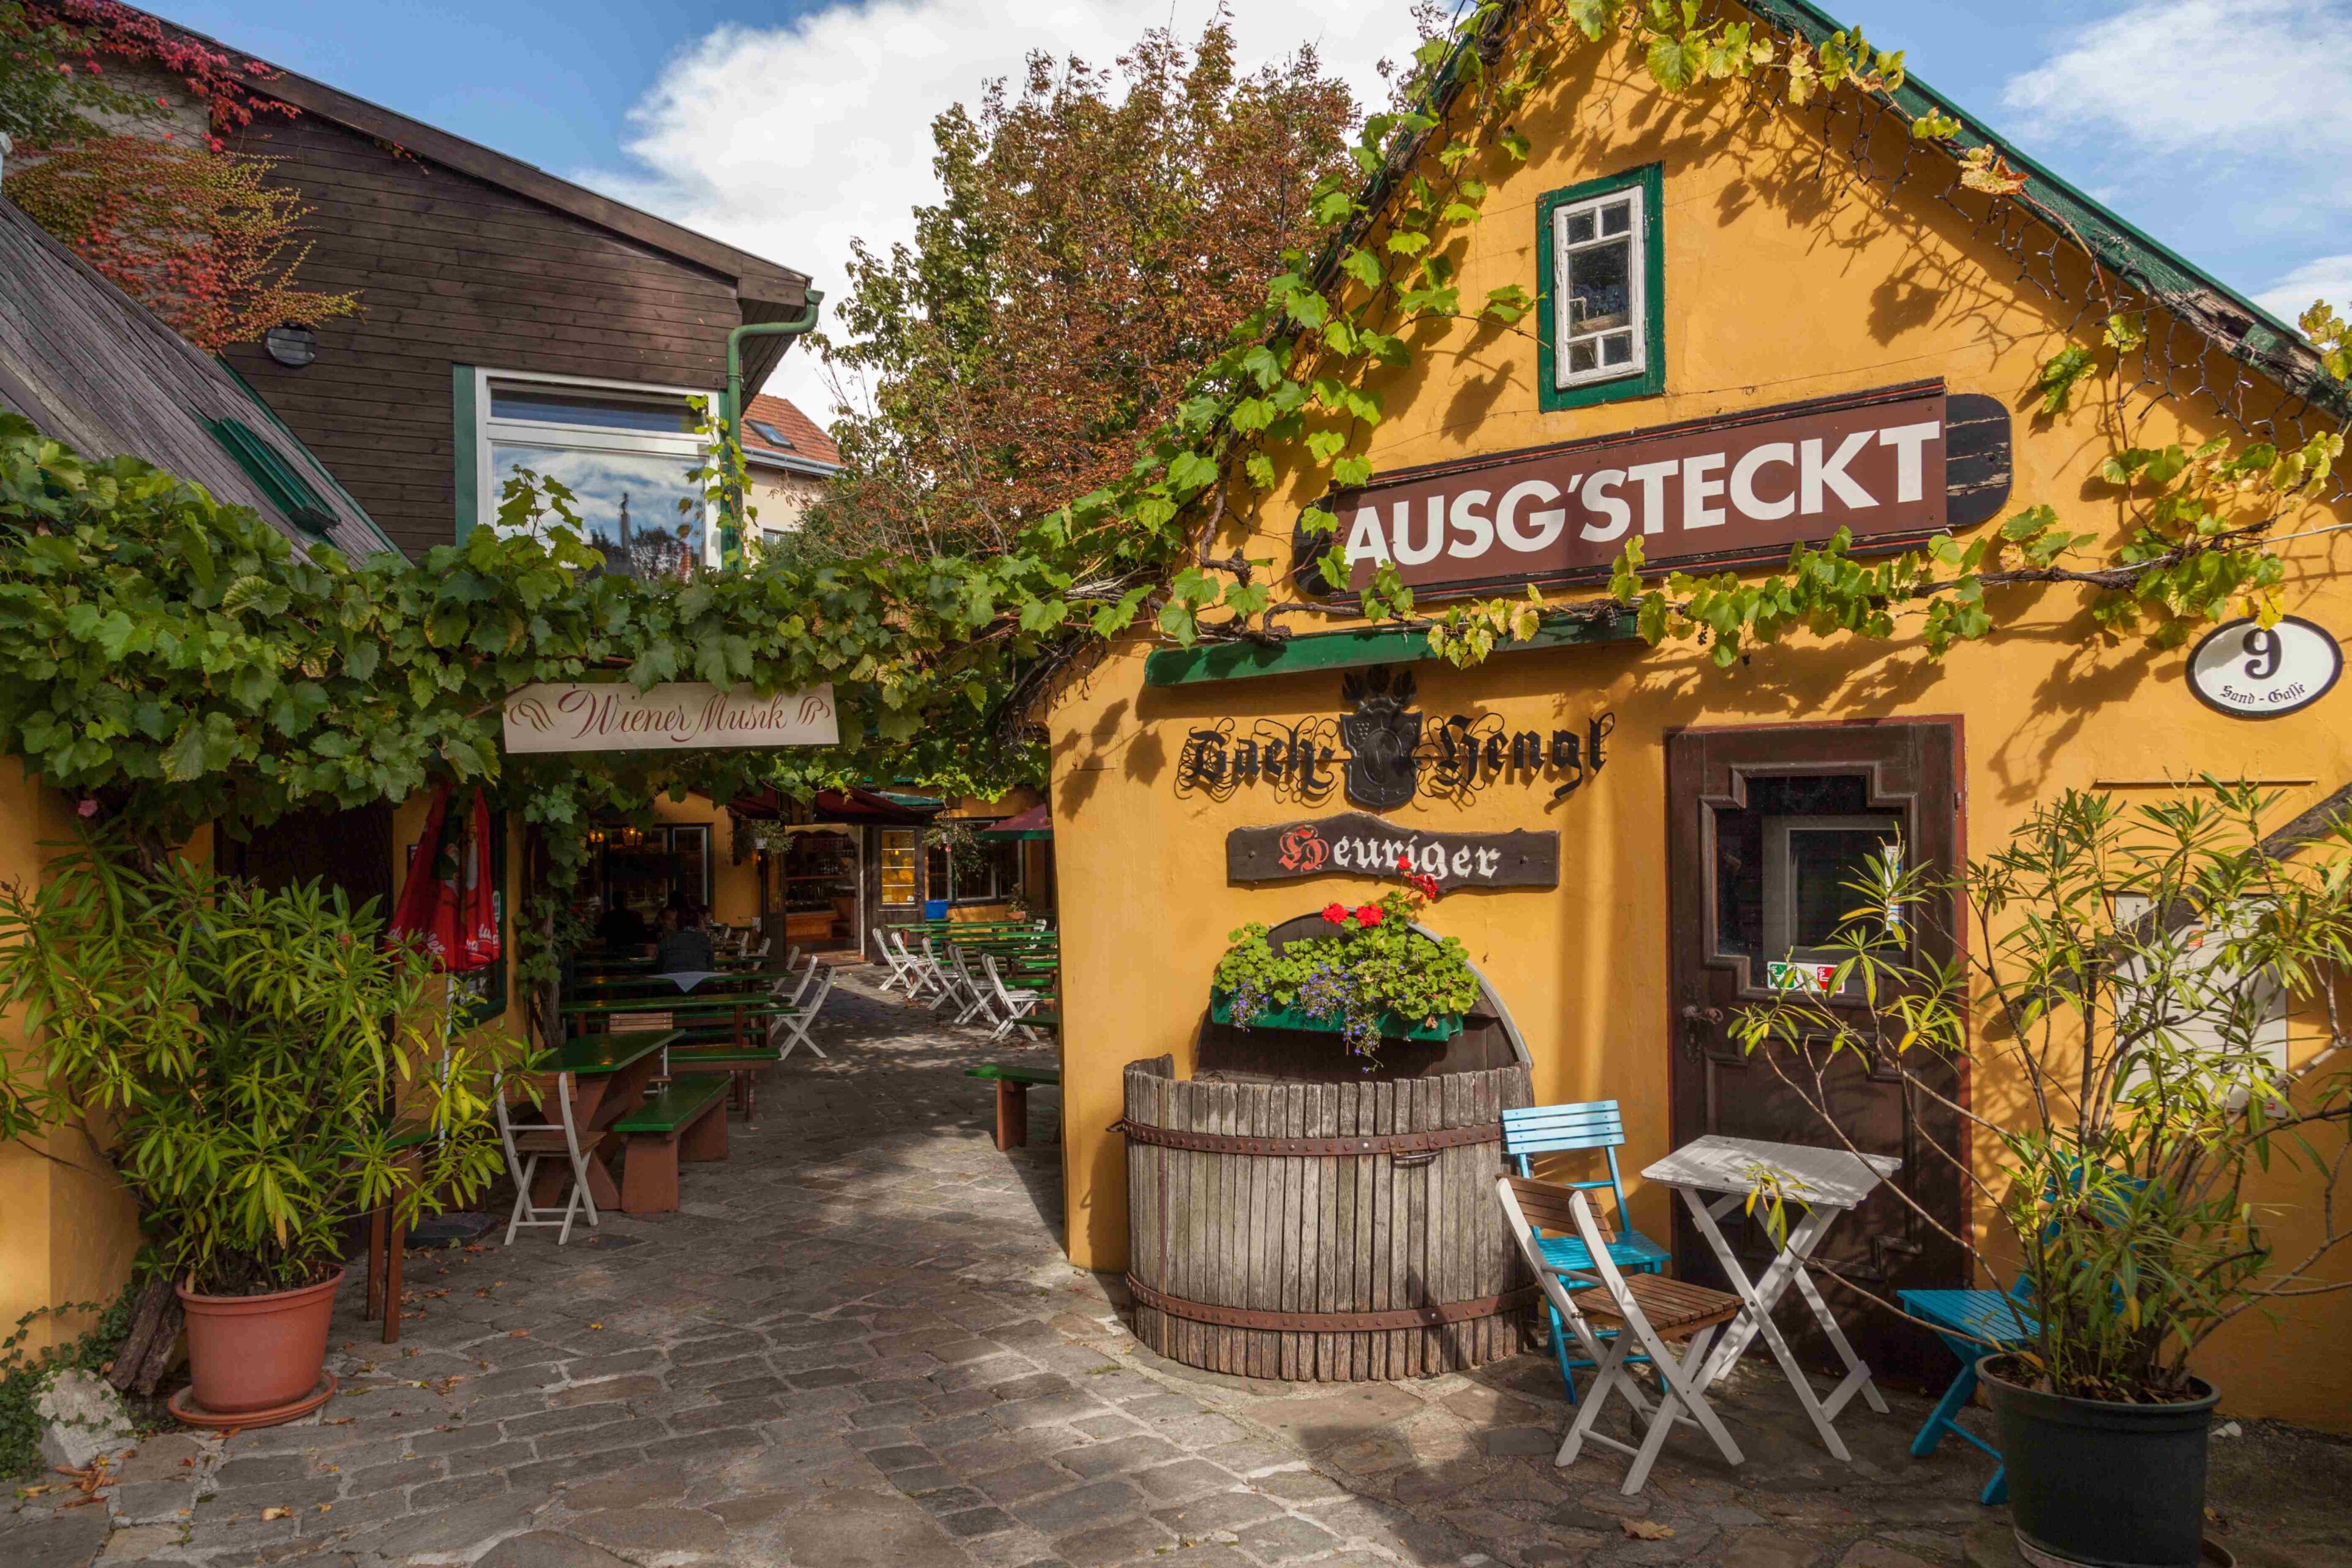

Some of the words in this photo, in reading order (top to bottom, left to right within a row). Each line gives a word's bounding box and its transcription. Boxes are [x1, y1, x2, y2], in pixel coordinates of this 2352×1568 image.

[1344, 420, 1941, 568] AUSG'STECKT
[2242, 627, 2282, 680] 9
[558, 689, 691, 739] Wiener
[671, 692, 788, 743] Musik
[2220, 685, 2256, 704] Sand
[1413, 712, 1615, 800] Hengl
[1278, 824, 1501, 880] Heuriger
